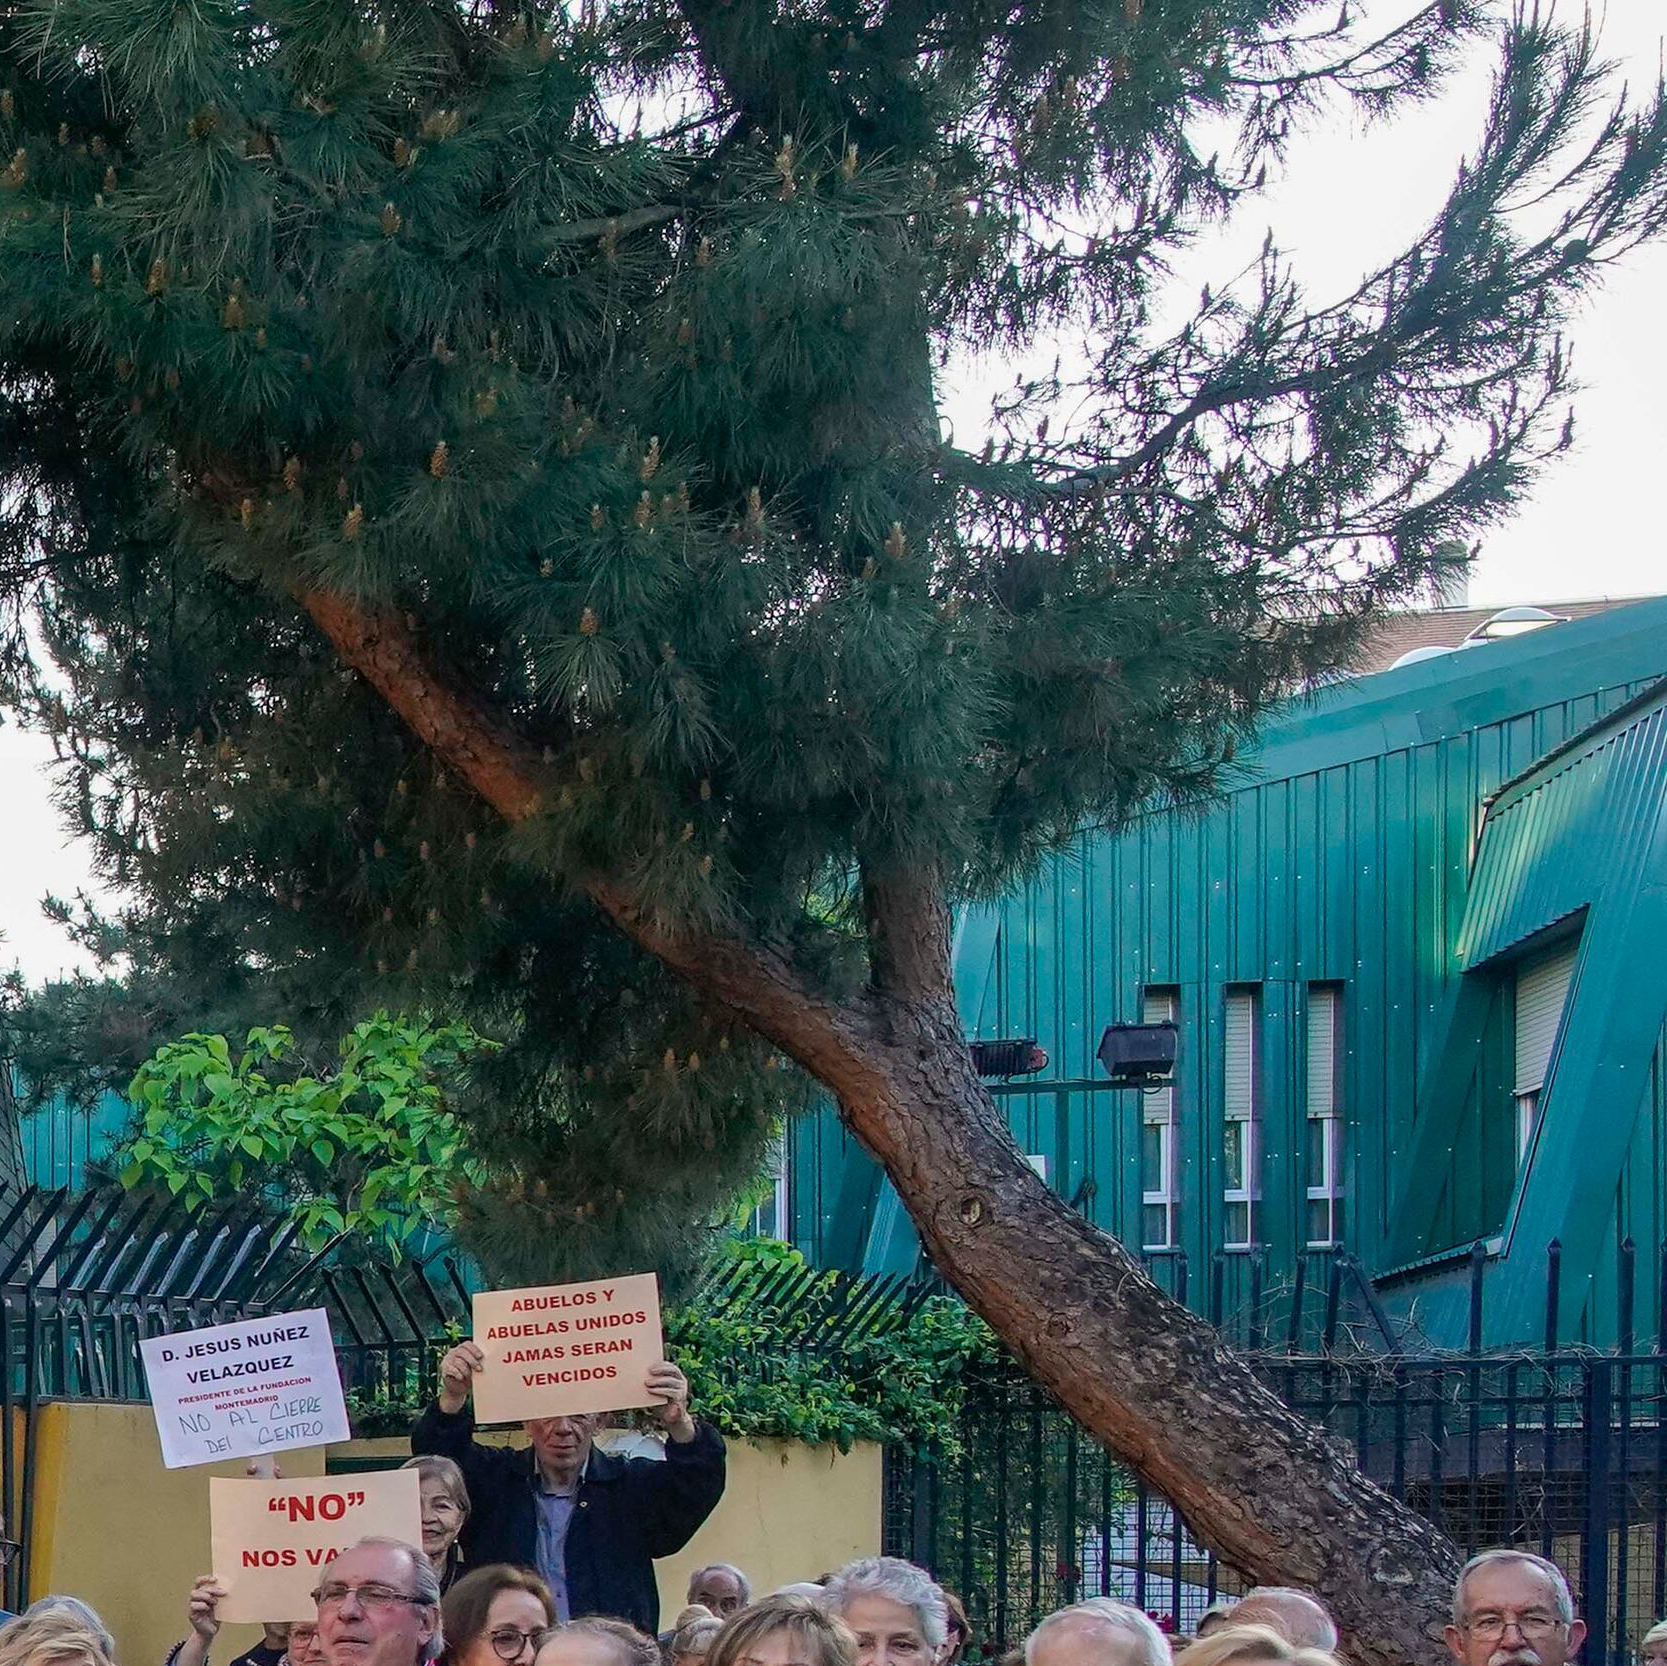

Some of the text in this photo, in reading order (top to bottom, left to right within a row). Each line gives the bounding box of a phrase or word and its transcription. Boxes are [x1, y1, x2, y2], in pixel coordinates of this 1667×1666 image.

[512, 1289, 614, 1311] ABUELOS Y
[488, 1311, 646, 1339] ABUELAS UNIDOS
[162, 1326, 309, 1362] D. JESUS NUÑEZ
[503, 1339, 632, 1363] JAMAS SERAN
[187, 1355, 295, 1385] VELAZQUEZ
[522, 1366, 617, 1386] VENCIDOS
[179, 1413, 210, 1434] NO
[229, 1409, 258, 1427] AL
[258, 1420, 323, 1445] CENTRO
[243, 1550, 296, 1567] NOS
